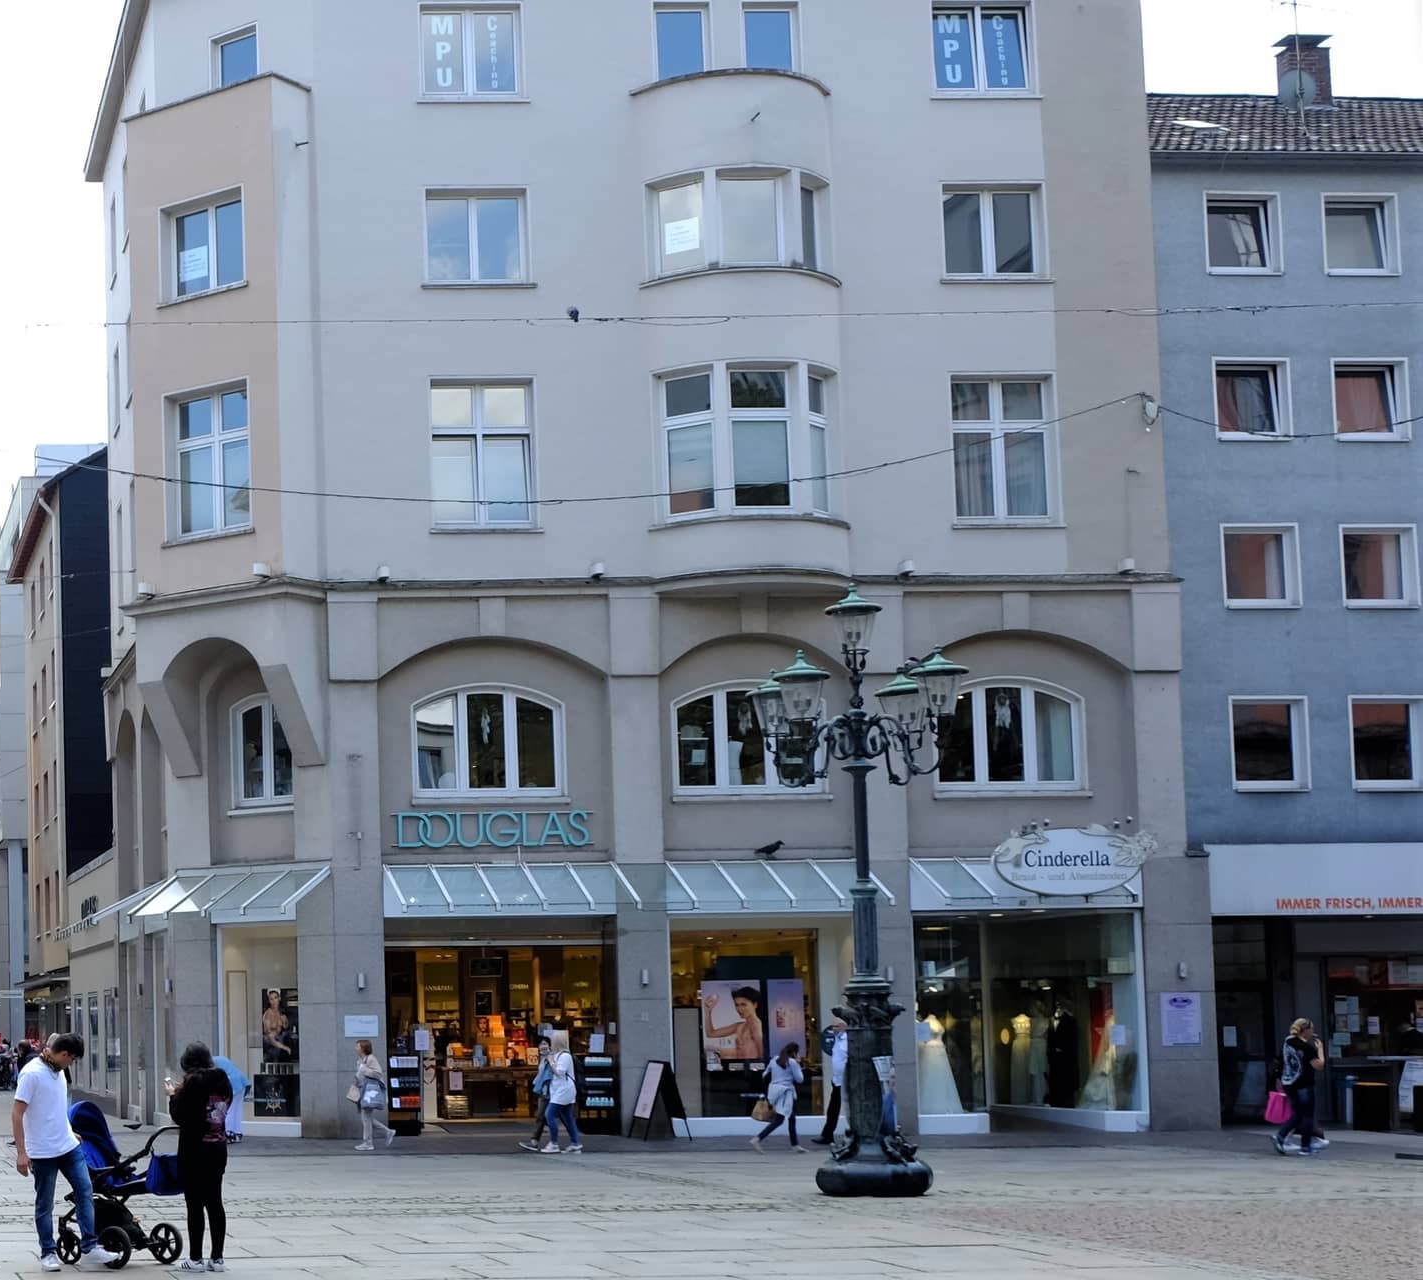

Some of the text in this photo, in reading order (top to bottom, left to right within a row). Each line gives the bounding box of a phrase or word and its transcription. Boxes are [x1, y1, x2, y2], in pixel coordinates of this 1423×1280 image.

[430, 15, 454, 87] MPU
[486, 15, 498, 89] Coaching
[937, 14, 962, 84] MPU
[991, 15, 1009, 86] Coaching
[398, 810, 590, 848] DOUGLAS
[1024, 849, 1111, 868] Cinderella
[1276, 896, 1423, 910] IMMER FRISCH, IMMER
